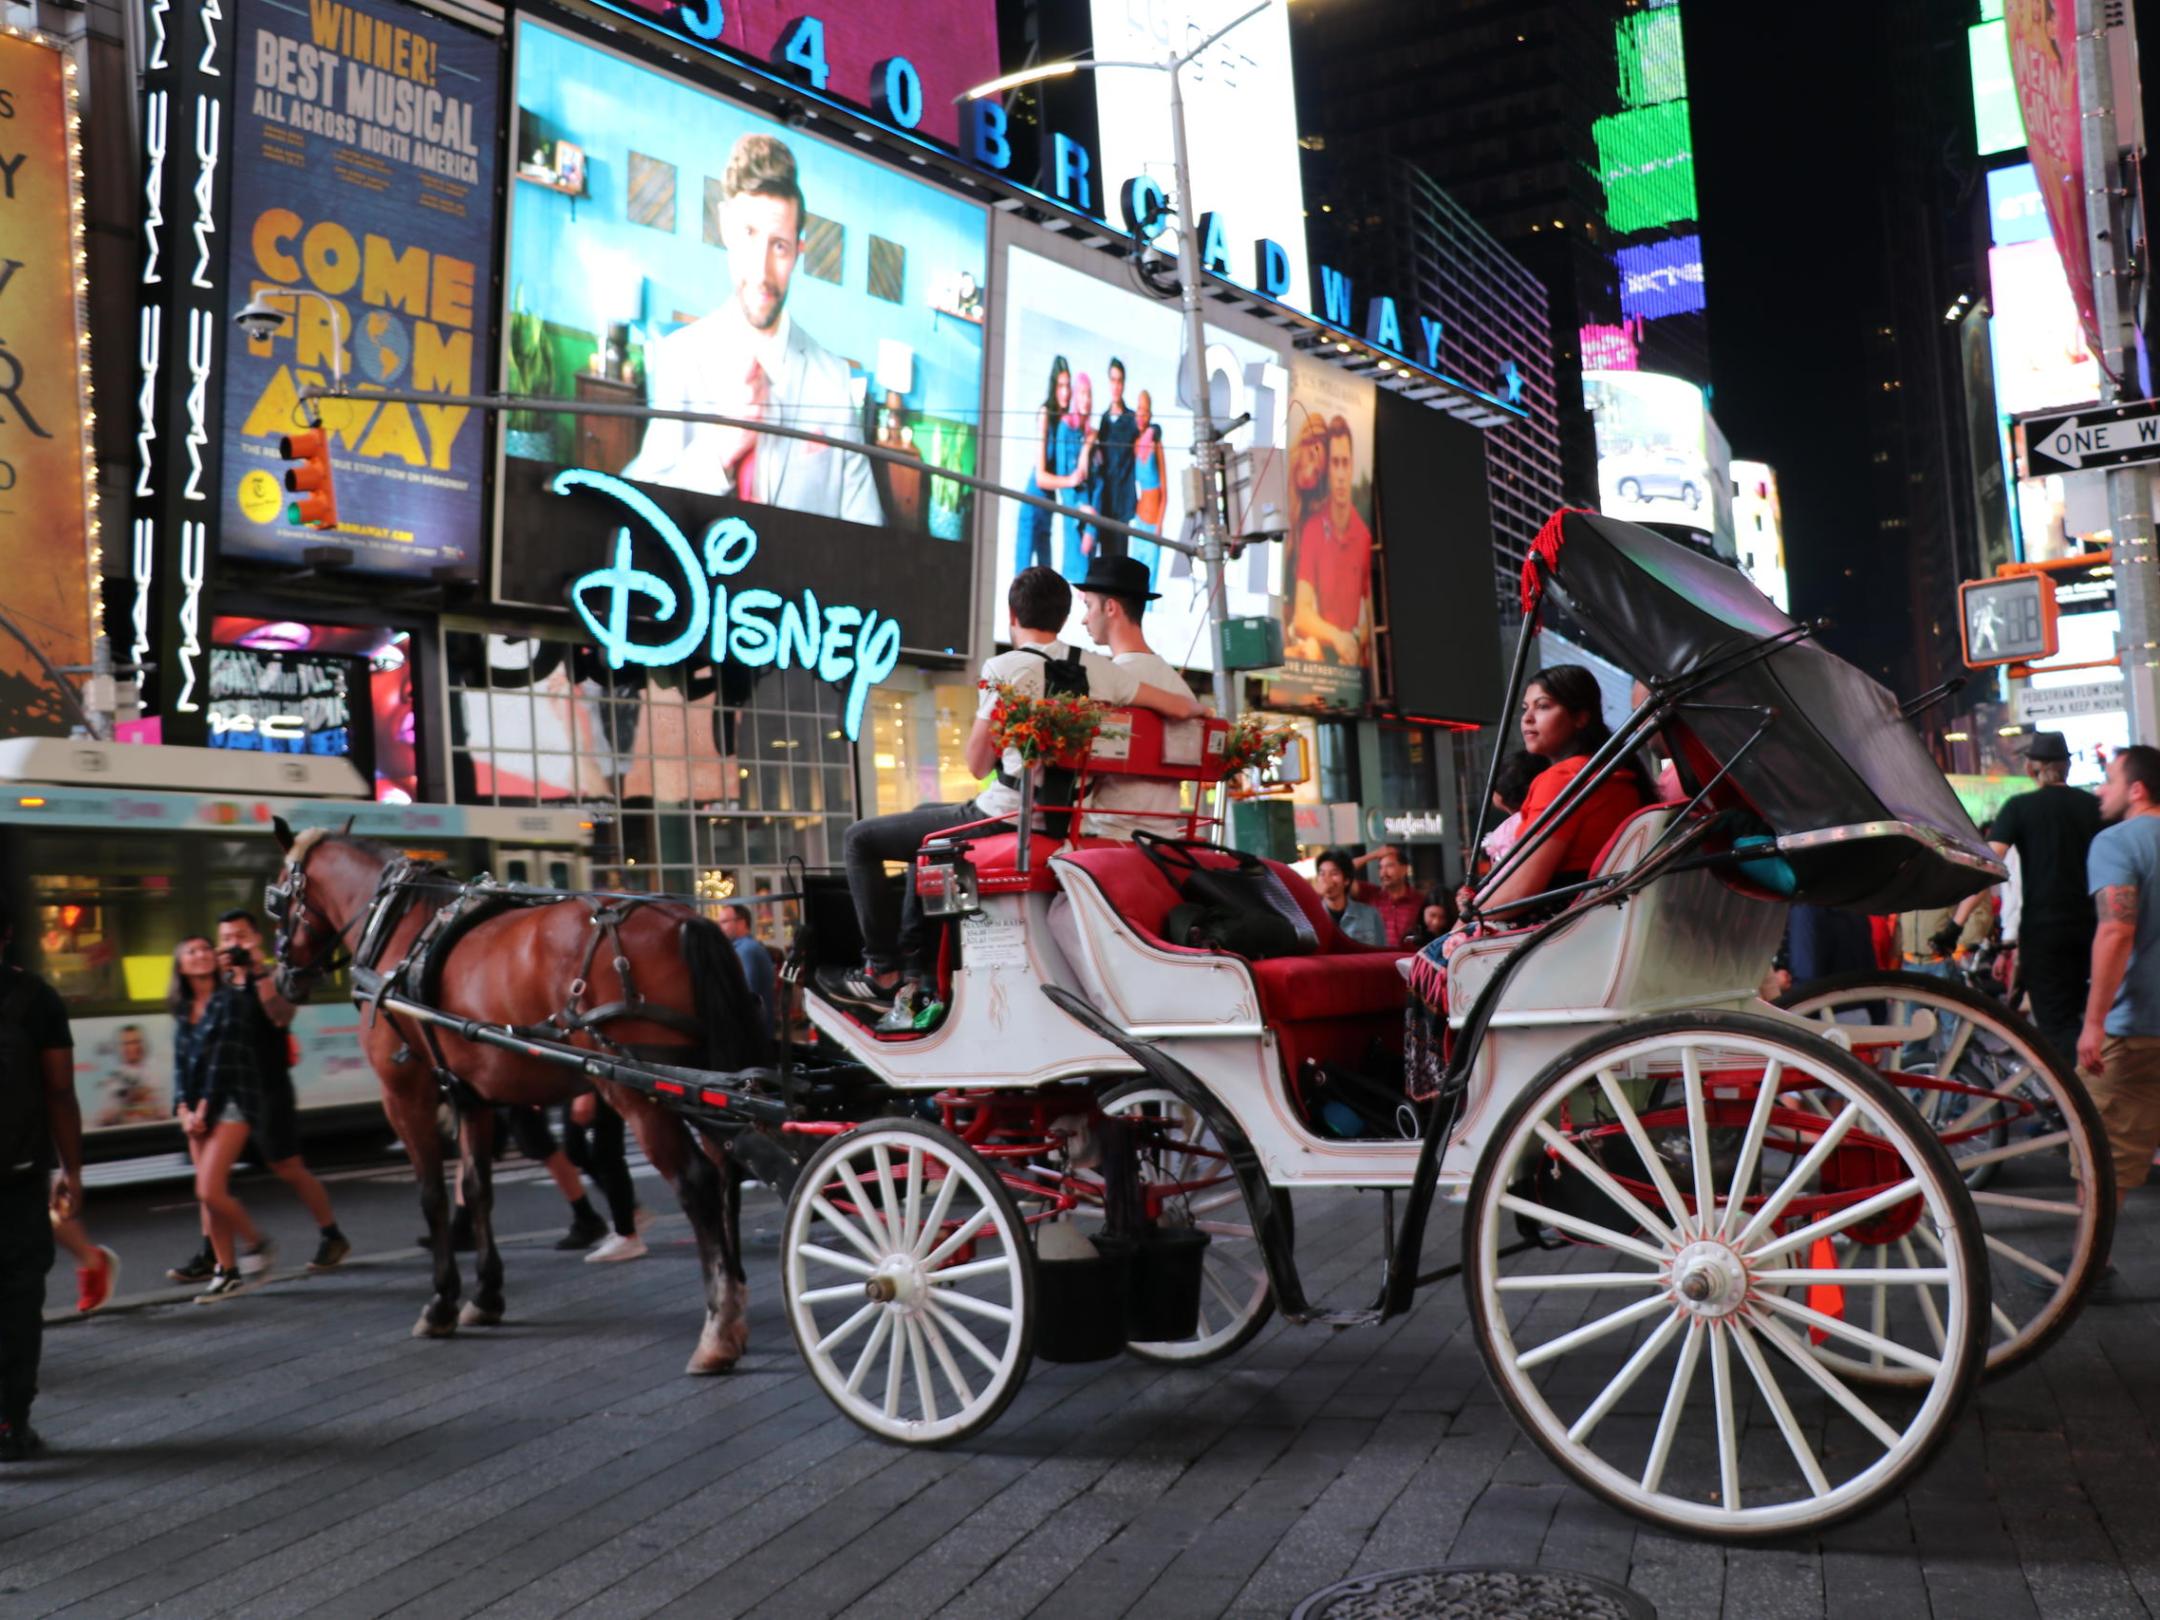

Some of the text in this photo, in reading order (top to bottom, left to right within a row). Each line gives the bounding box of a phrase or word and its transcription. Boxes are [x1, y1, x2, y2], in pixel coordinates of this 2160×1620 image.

[256, 29, 339, 107] BEST
[347, 61, 479, 156] MUSICAL
[310, 0, 437, 86] WINNER!
[253, 88, 285, 122] ALL
[290, 101, 356, 144] ACROSS
[361, 123, 410, 162] NORTH
[413, 140, 479, 185] AMERICA
[252, 208, 475, 329] COME
[977, 101, 1443, 369] BROADWAY
[241, 364, 470, 471] AWAY
[2056, 427, 2110, 455] ONE
[422, 474, 468, 490] BROADWAY
[552, 468, 900, 741] Disney
[2103, 681, 2121, 695] ZON
